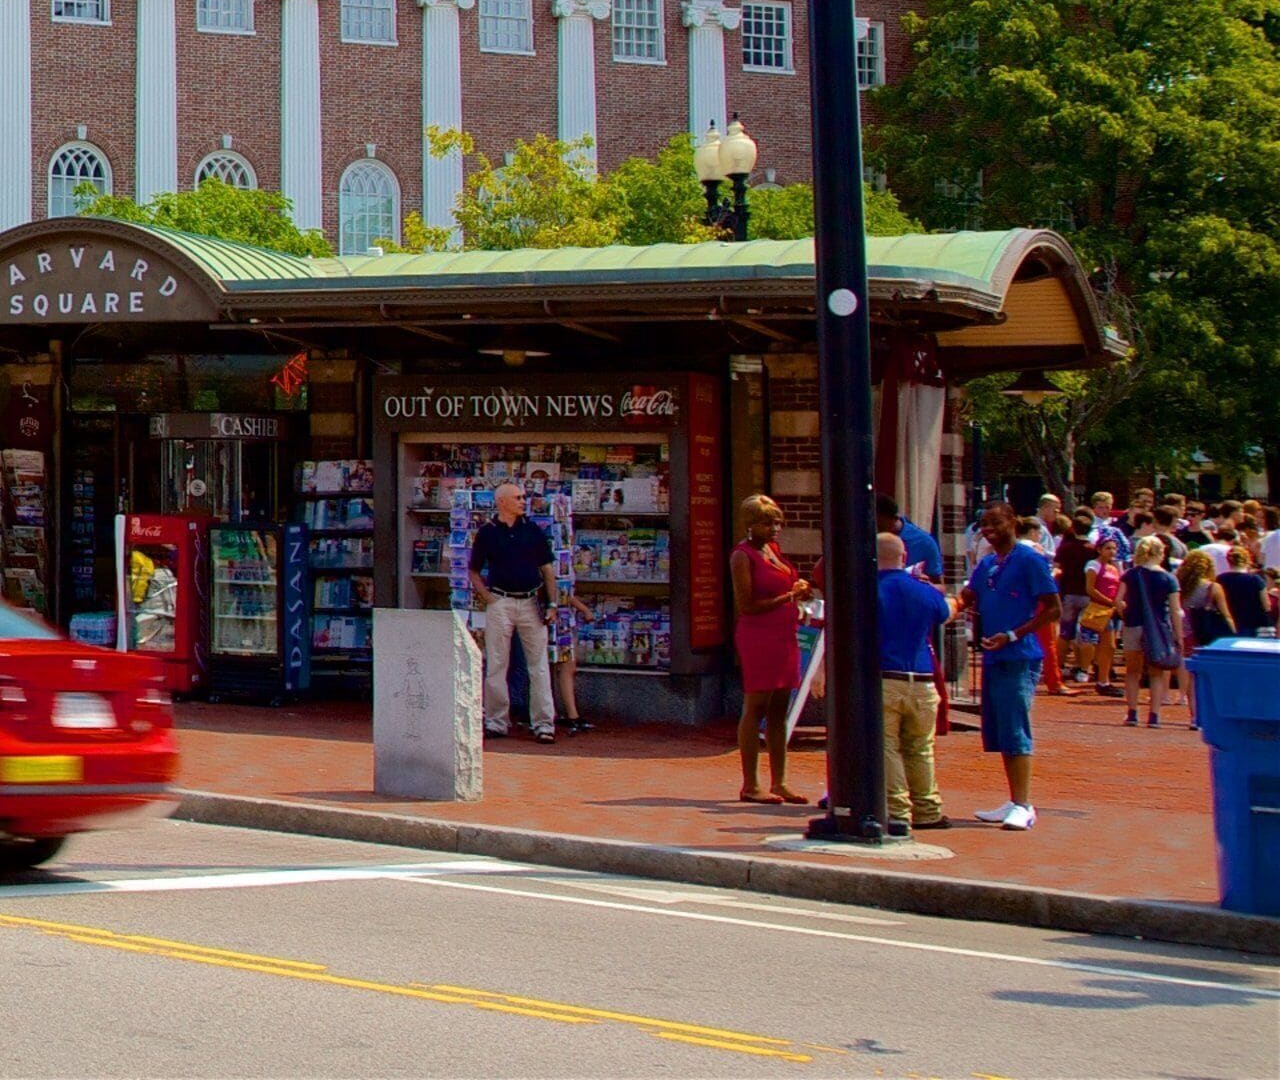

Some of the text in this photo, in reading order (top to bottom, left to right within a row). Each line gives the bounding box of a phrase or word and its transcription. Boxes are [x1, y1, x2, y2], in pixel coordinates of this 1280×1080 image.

[10, 292, 144, 316] SQUARE
[384, 396, 431, 417] OUT
[436, 396, 465, 417] OF
[470, 396, 540, 417] TOWN
[546, 395, 614, 417] NEWS
[220, 416, 278, 437] CASHIER
[289, 525, 304, 668] DASANI
